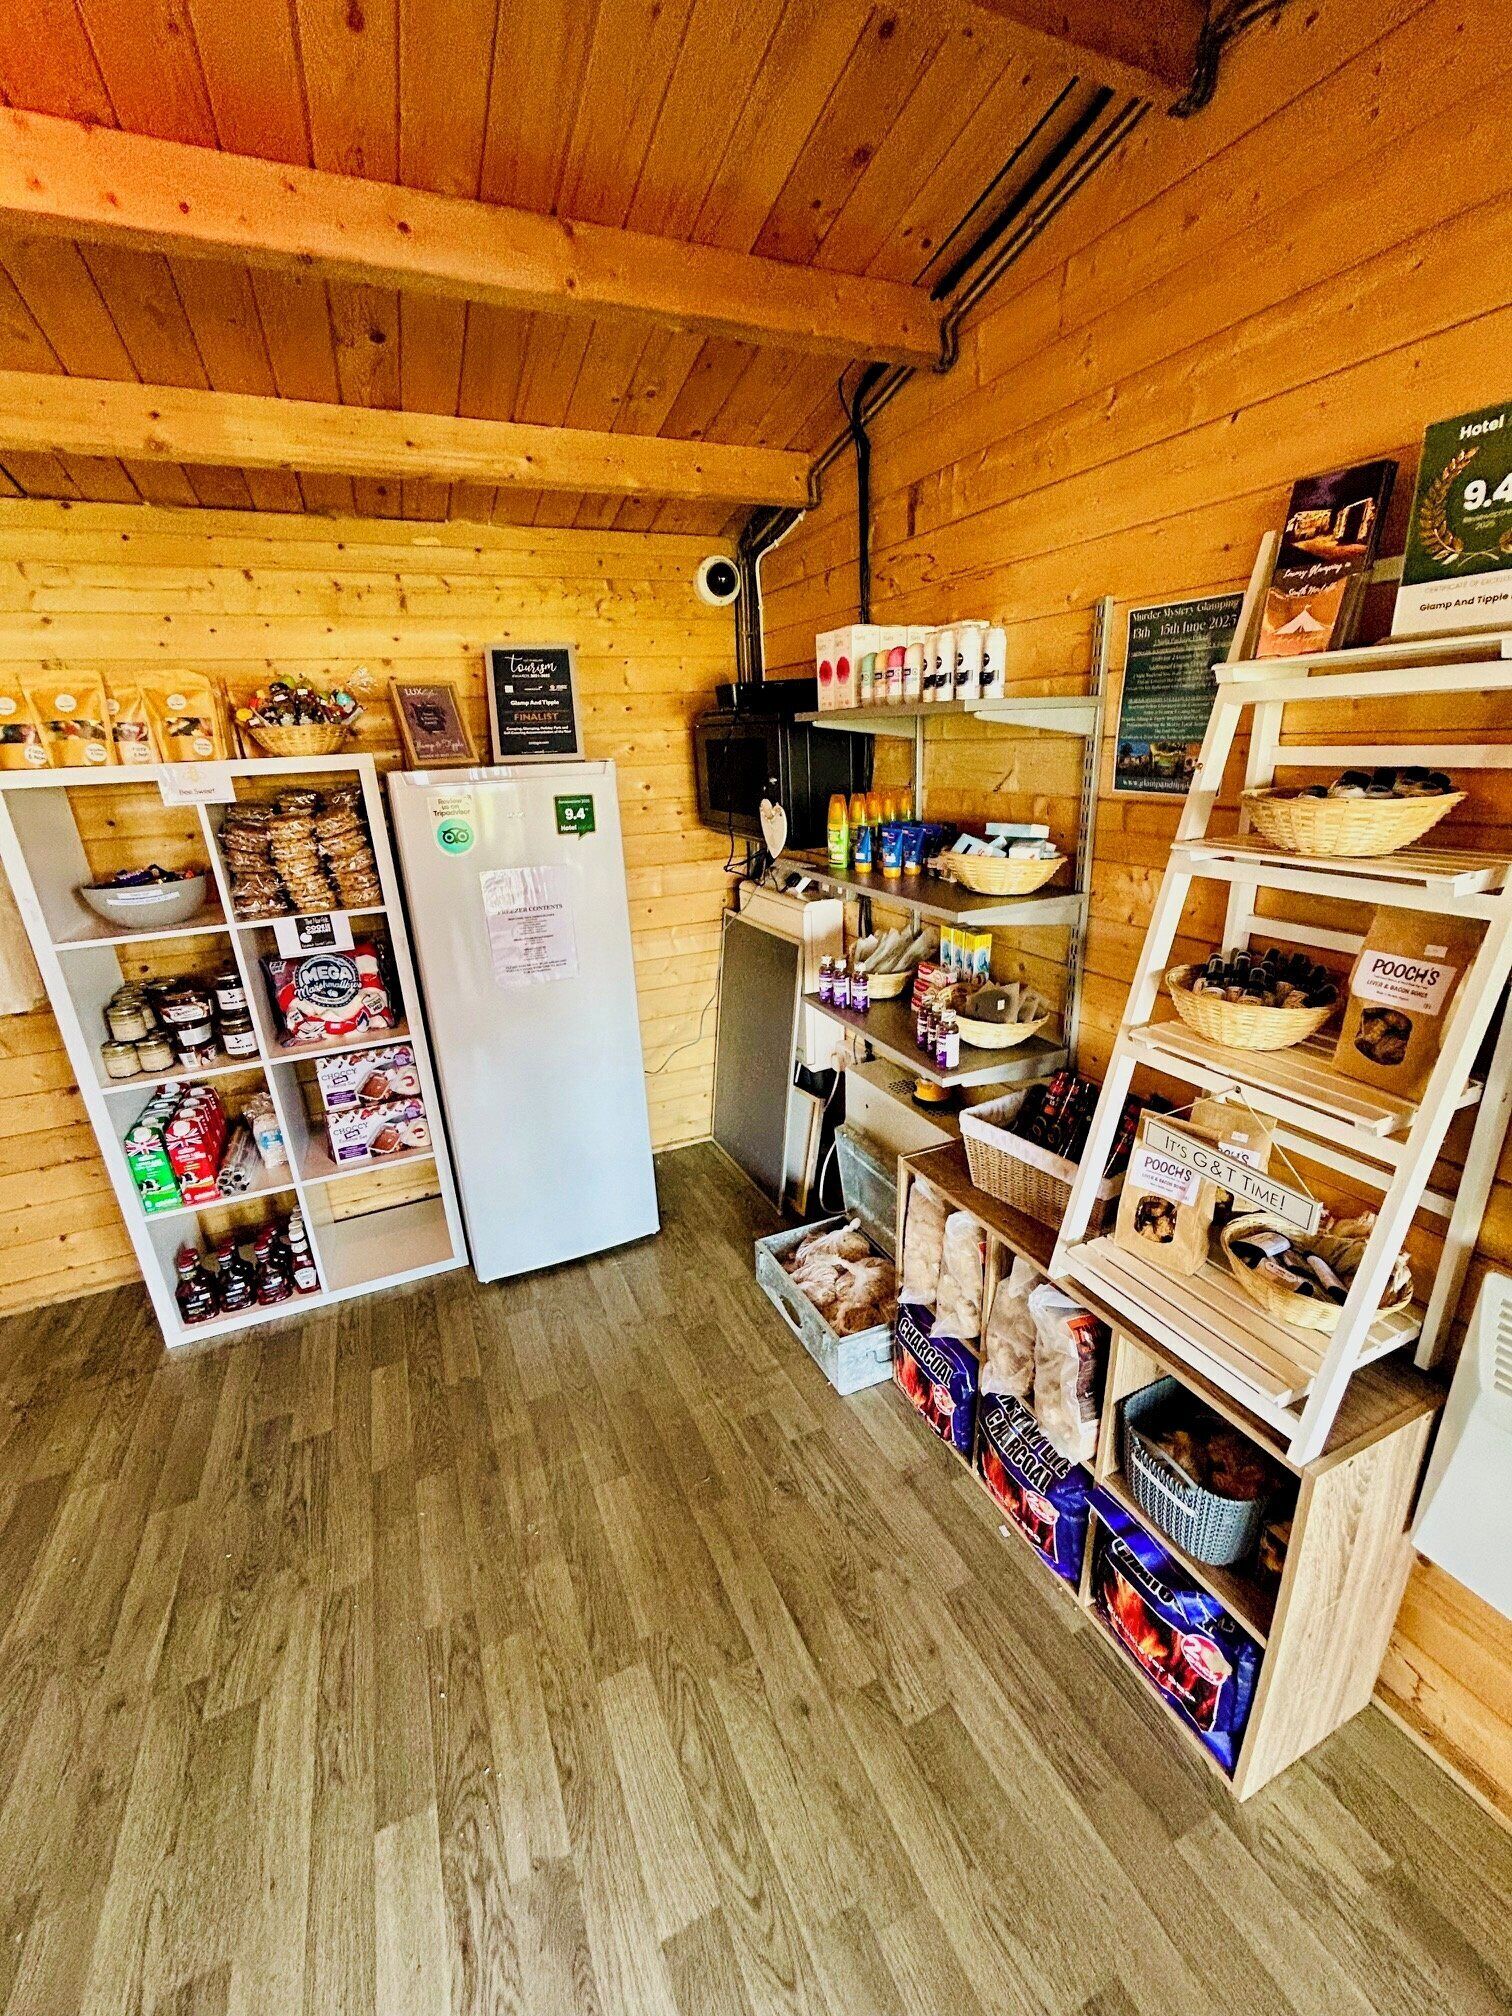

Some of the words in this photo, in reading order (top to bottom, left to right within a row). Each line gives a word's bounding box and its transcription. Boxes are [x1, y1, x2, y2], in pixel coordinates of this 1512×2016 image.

[1458, 414, 1505, 441] Hotel
[1462, 473, 1512, 511] 9.4
[1307, 561, 1343, 578] Glamping
[1132, 611, 1161, 621] Murder
[1163, 607, 1194, 618] Mystery
[1197, 599, 1239, 612] Glamping
[1419, 600, 1452, 612] Glamp
[1454, 597, 1475, 607] And
[1478, 592, 1509, 604] Tipple
[1133, 627, 1151, 640] 13th
[1160, 623, 1180, 636] 15th
[1182, 619, 1206, 633] June
[1208, 614, 1237, 630] 2025
[504, 654, 557, 675] tourism
[514, 712, 559, 721] FINALIST
[433, 809, 470, 817] Tripadvisor
[564, 808, 586, 820] 9.4
[497, 907, 528, 915] FREEZER
[302, 965, 354, 985] MEGA
[1372, 957, 1440, 987] POOCH'S
[1366, 979, 1382, 989] LIVER
[1392, 985, 1411, 994] BACON
[321, 1068, 356, 1081] CHOCCY
[333, 1122, 368, 1135] CHOCCY
[1164, 1135, 1188, 1160] IT'S
[1242, 1175, 1286, 1211] TIME!
[899, 1317, 954, 1389] CHARCOAL
[985, 1408, 1053, 1496] CHARCOAL
